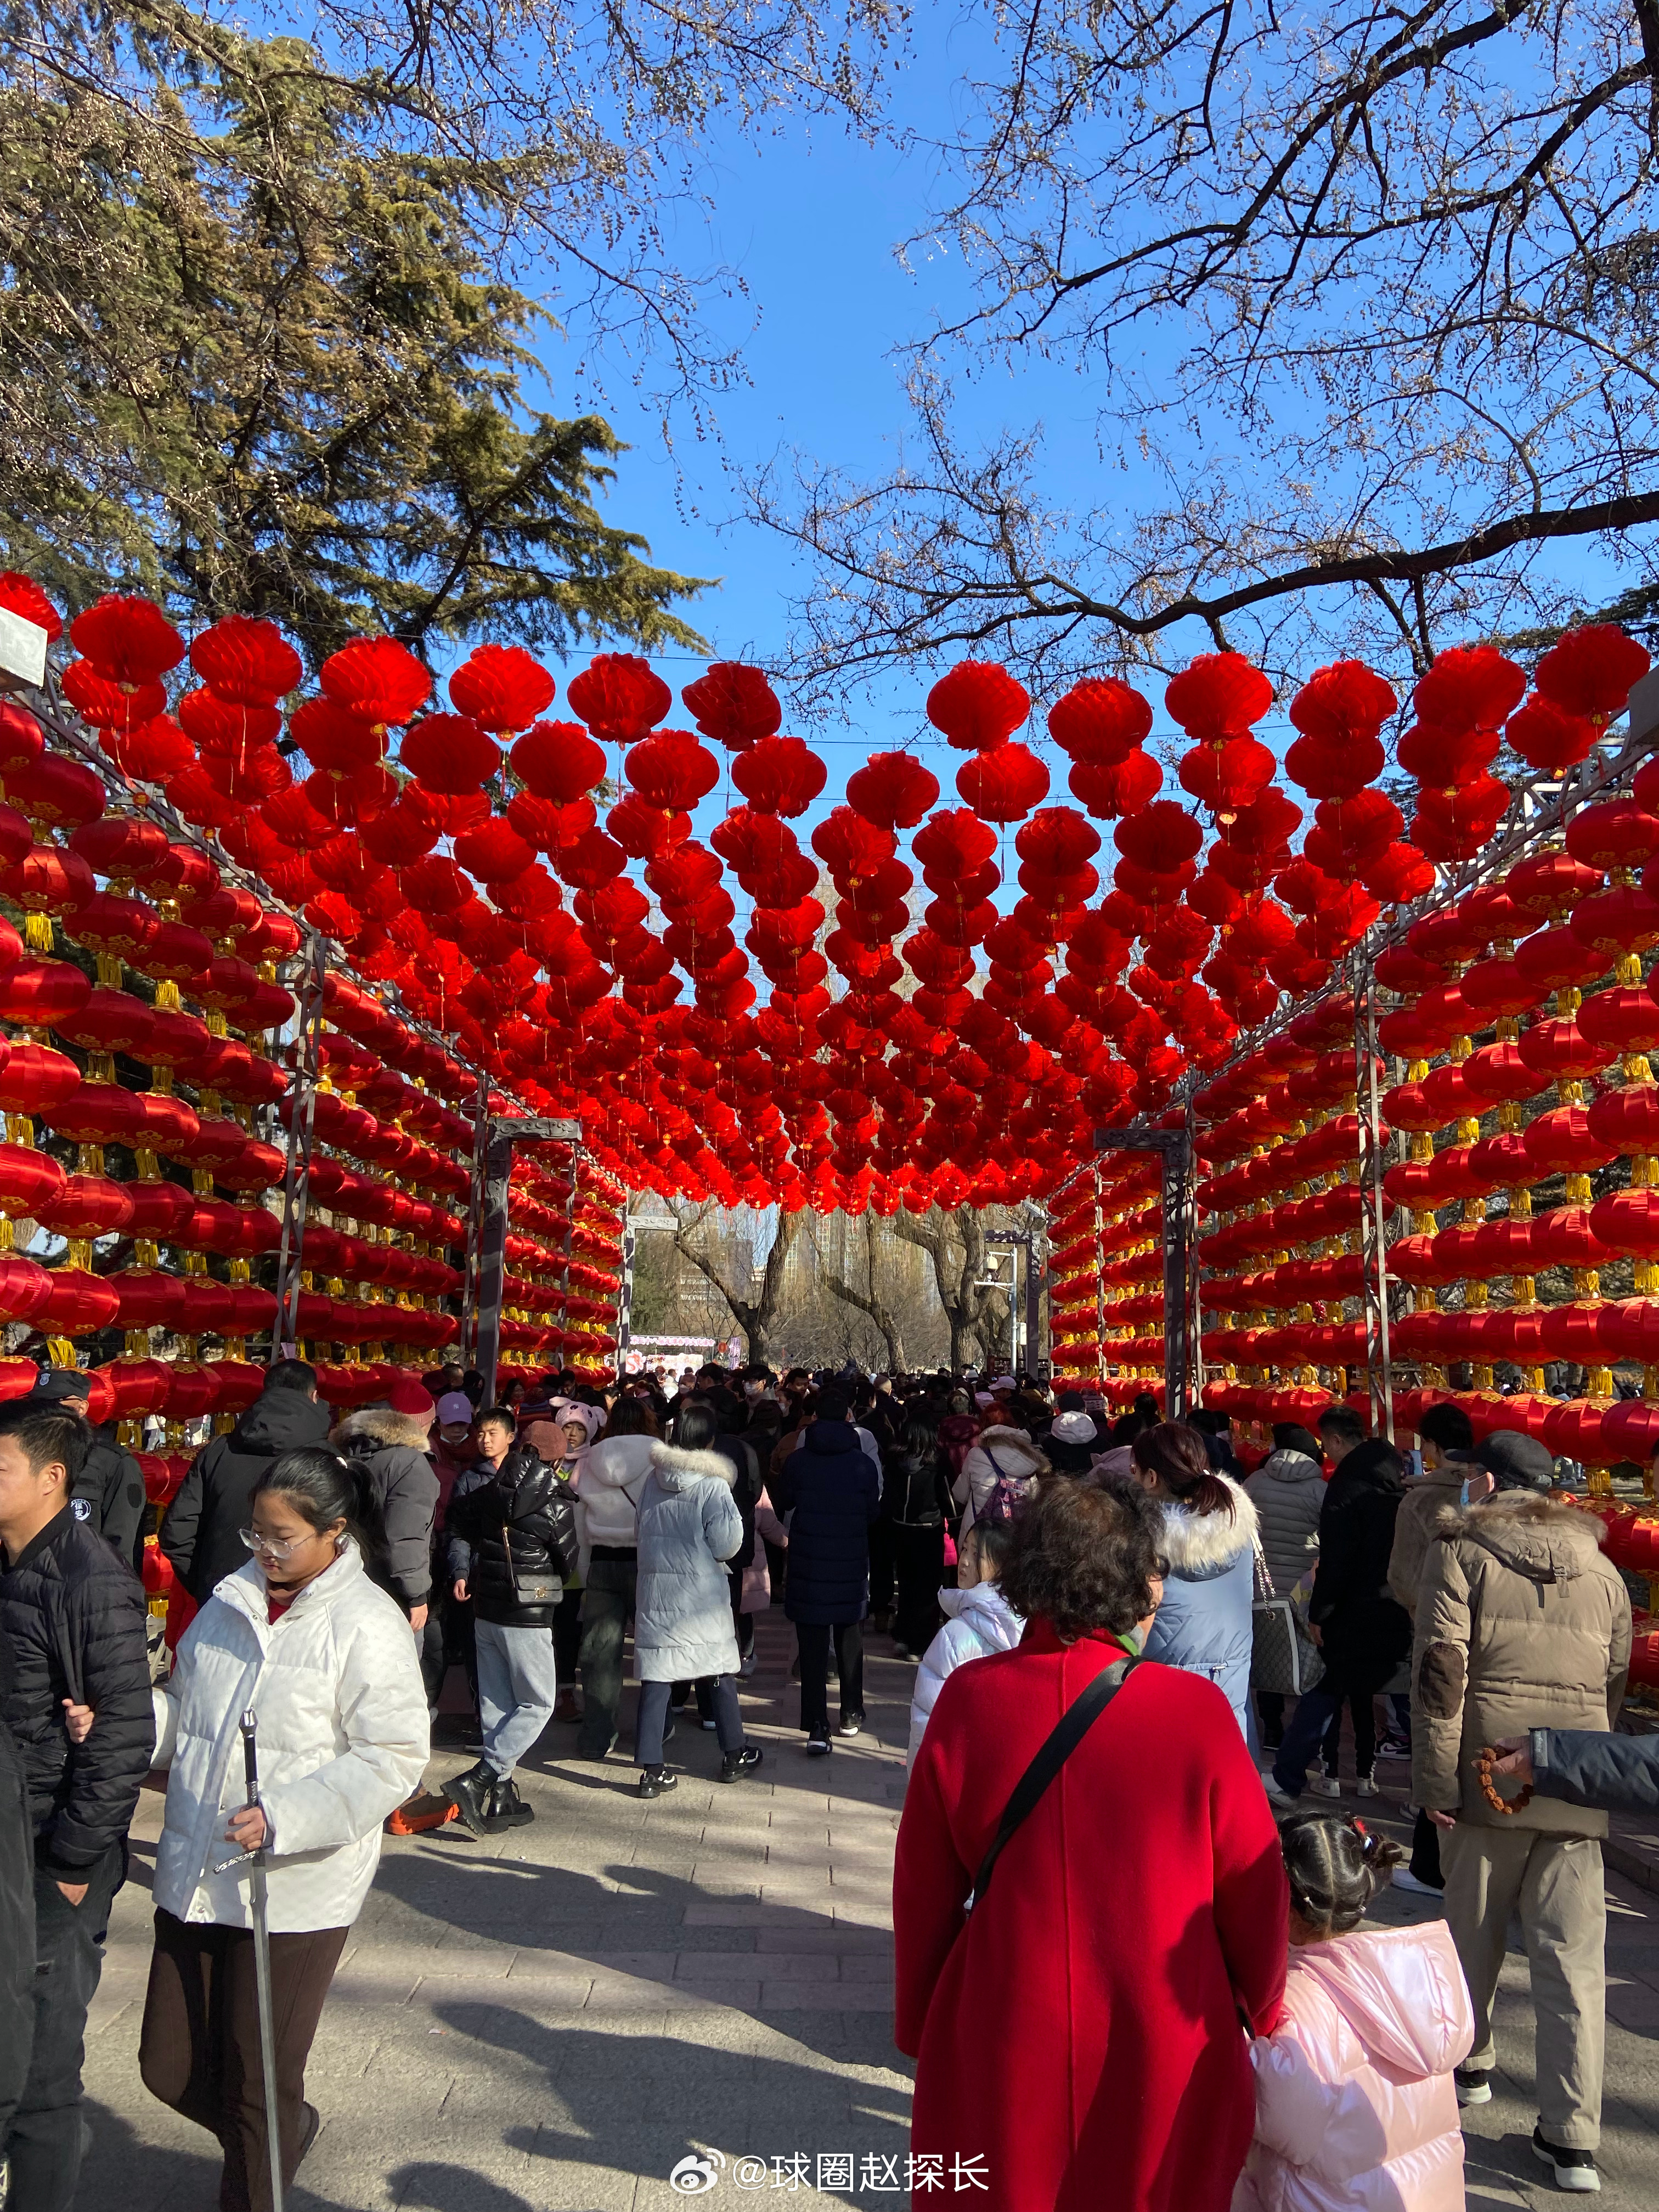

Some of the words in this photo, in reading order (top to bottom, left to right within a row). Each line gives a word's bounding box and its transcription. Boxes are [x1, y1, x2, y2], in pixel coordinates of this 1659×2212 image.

[1592, 714, 1602, 724] 福
[1212, 740, 1223, 750] 福
[1252, 867, 1261, 877] 福
[1222, 924, 1232, 935] 福
[75, 1503, 83, 1518] 保安
